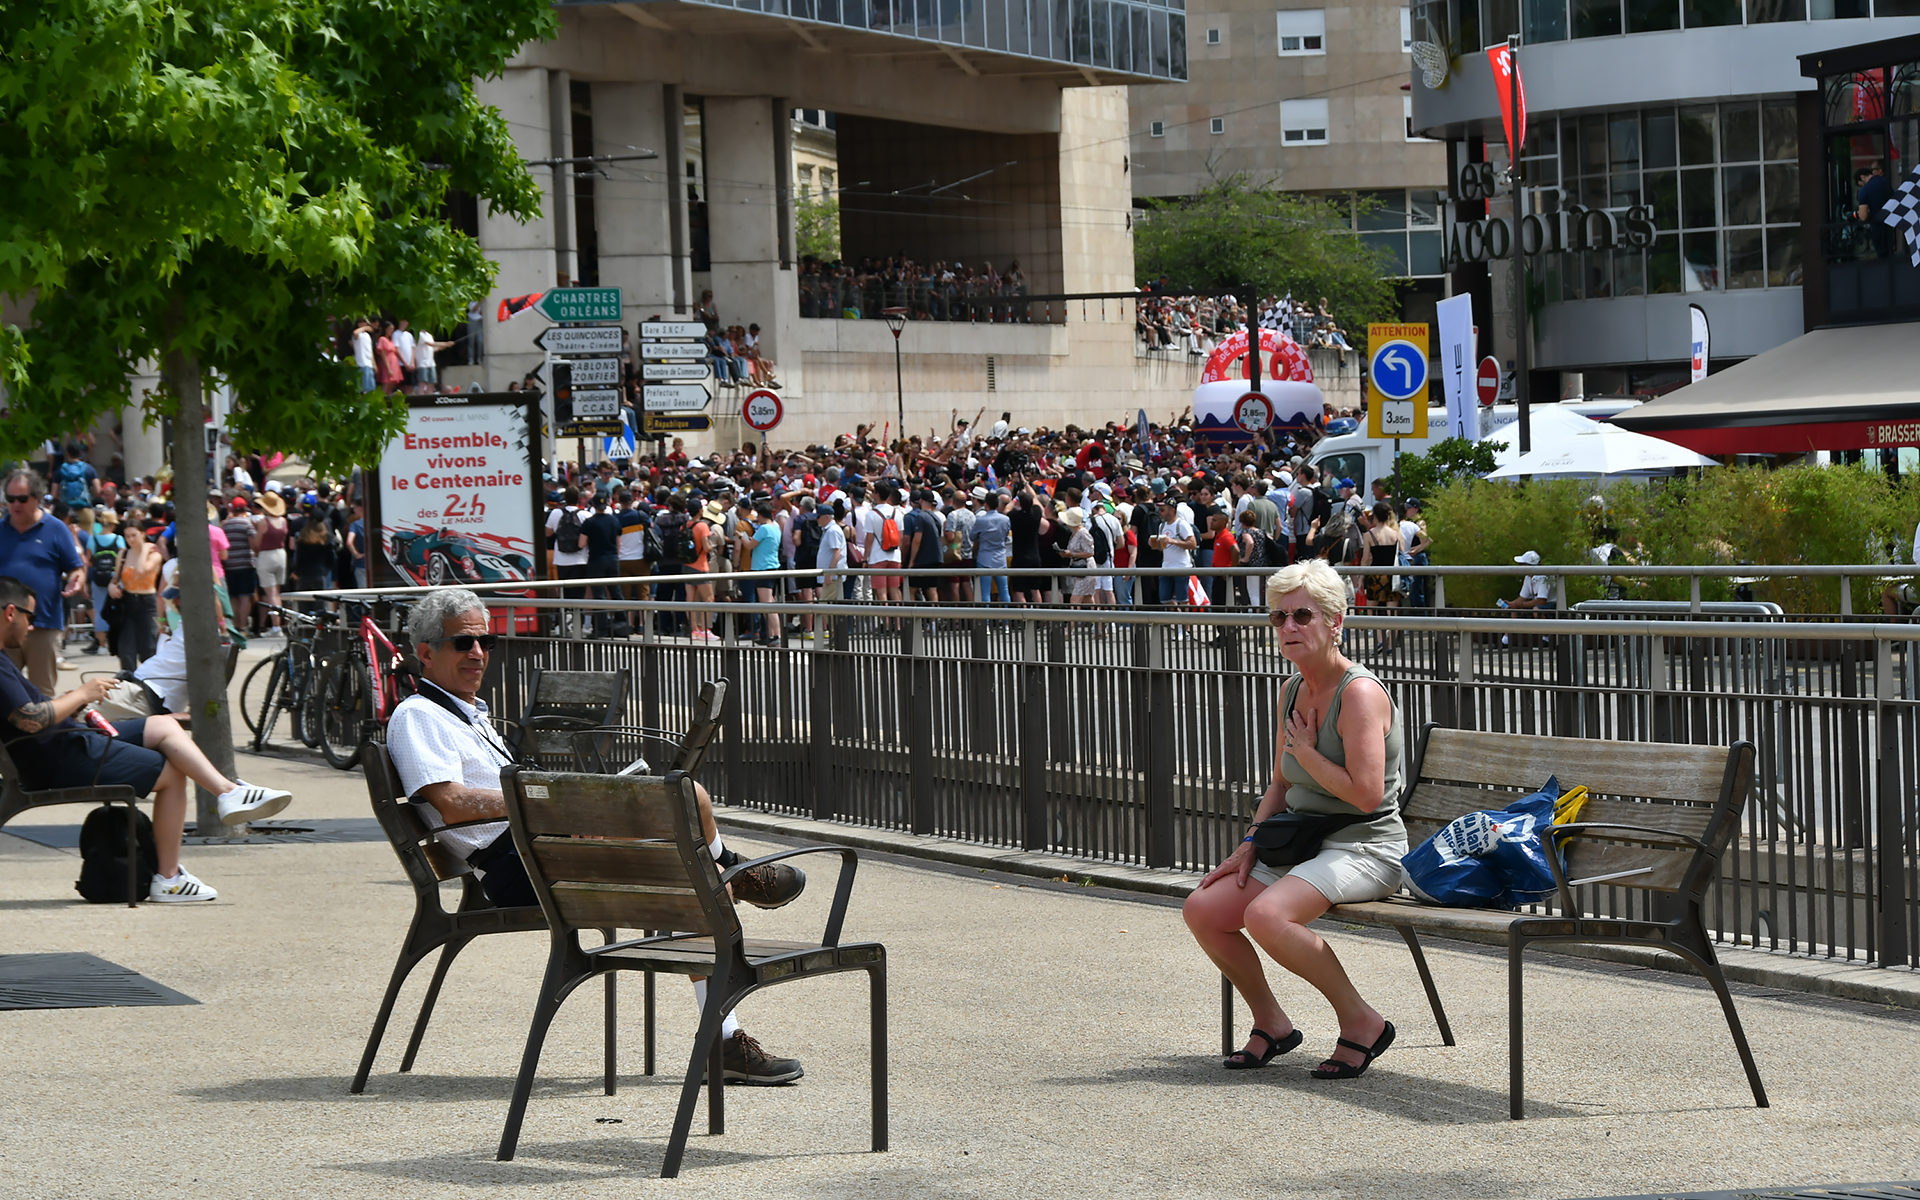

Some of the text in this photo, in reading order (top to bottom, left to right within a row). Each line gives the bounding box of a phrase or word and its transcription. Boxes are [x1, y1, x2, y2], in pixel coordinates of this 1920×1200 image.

[553, 292, 617, 304] CHARTRES
[560, 304, 617, 317] ORLÉANS
[644, 326, 659, 334] Gare
[1370, 326, 1426, 337] ATTENTION
[546, 330, 619, 341] LES QUINCONCES
[653, 346, 704, 355] Office de Tourisme
[570, 361, 616, 371] SABLONS
[645, 367, 705, 376] Chambre de Commerce
[646, 388, 680, 397] Préfecture
[578, 394, 616, 402] Judiciaire
[646, 398, 698, 407] Conseil Général
[654, 418, 690, 428] République
[563, 425, 577, 434] Les
[1878, 423, 1920, 443] BRASSER
[404, 431, 508, 450] Ensemble,
[427, 453, 487, 469] vivons
[391, 470, 523, 490] le Centenaire
[417, 508, 439, 518] des
[441, 516, 484, 525] LE MANS
